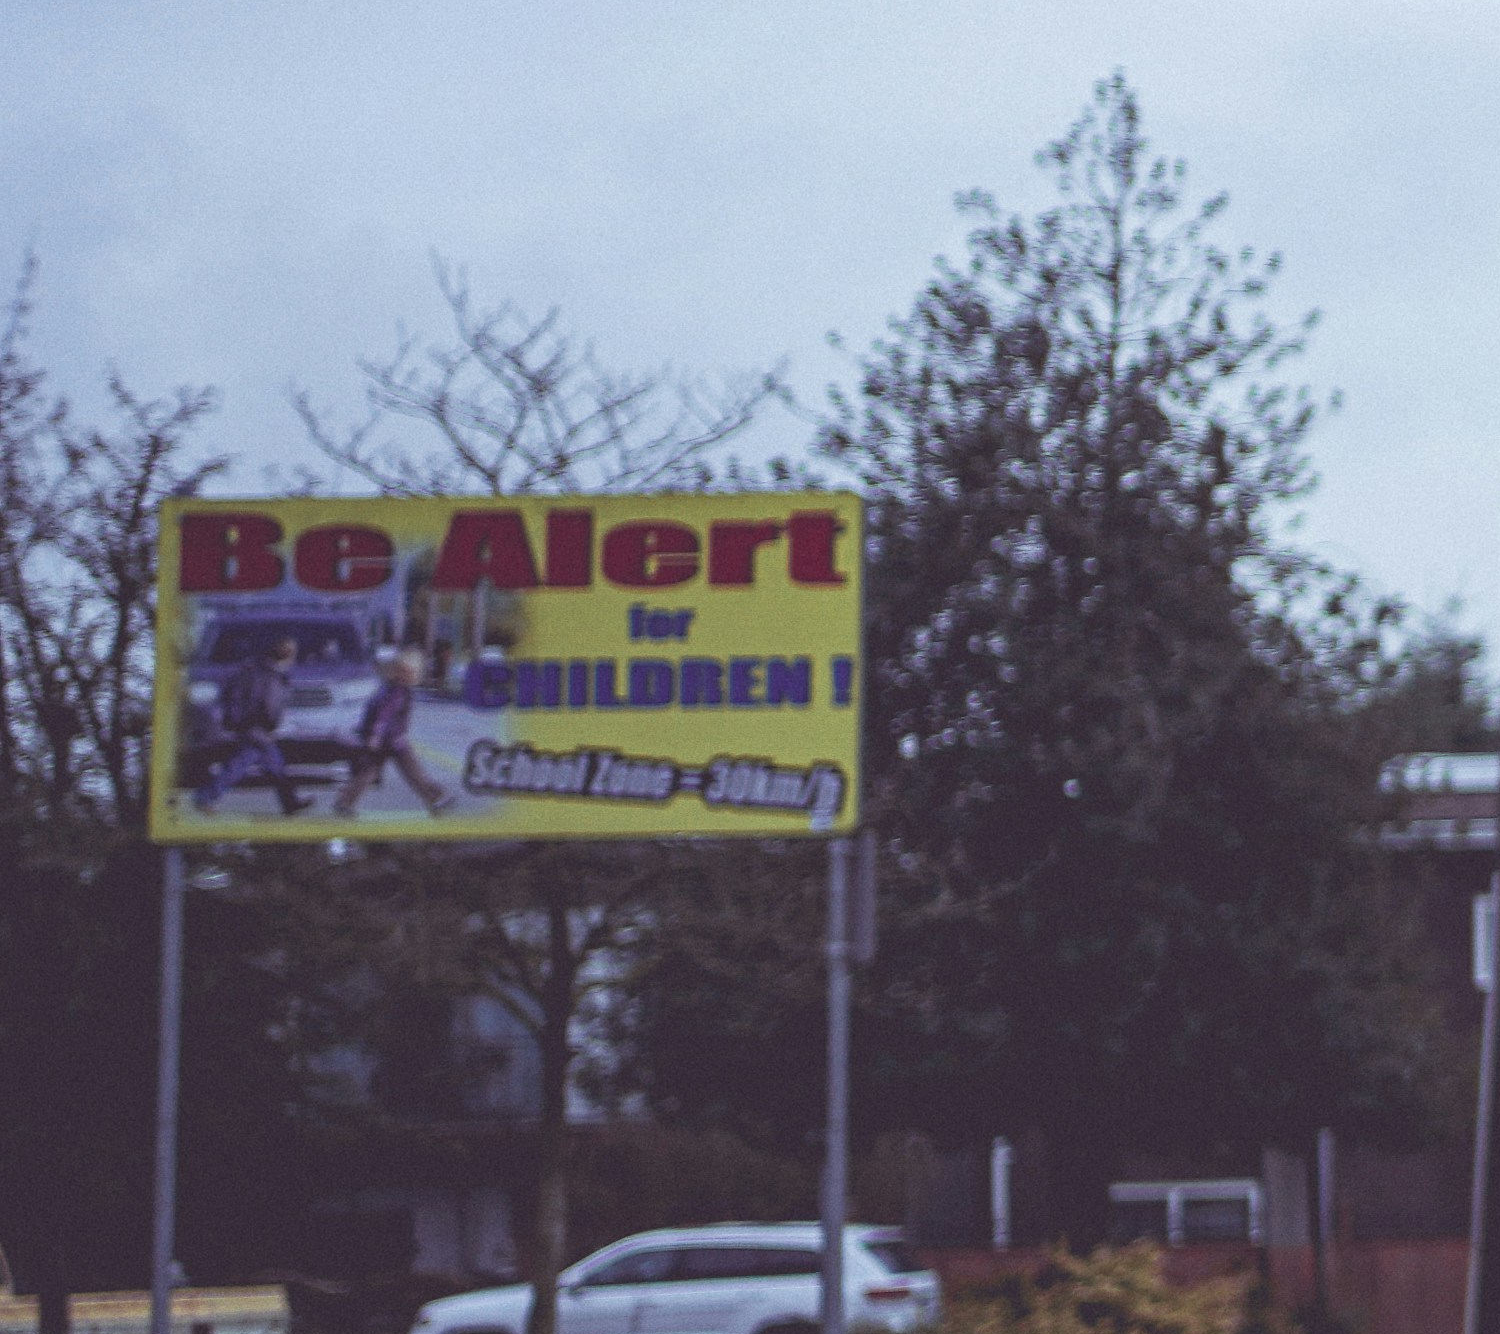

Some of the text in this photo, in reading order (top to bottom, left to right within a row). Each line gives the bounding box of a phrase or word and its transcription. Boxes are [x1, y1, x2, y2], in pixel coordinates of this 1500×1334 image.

[179, 509, 848, 592] Be Alert
[628, 602, 694, 642] for
[466, 657, 812, 709] CHILDREN
[466, 742, 590, 795] School
[591, 750, 675, 800] Zone
